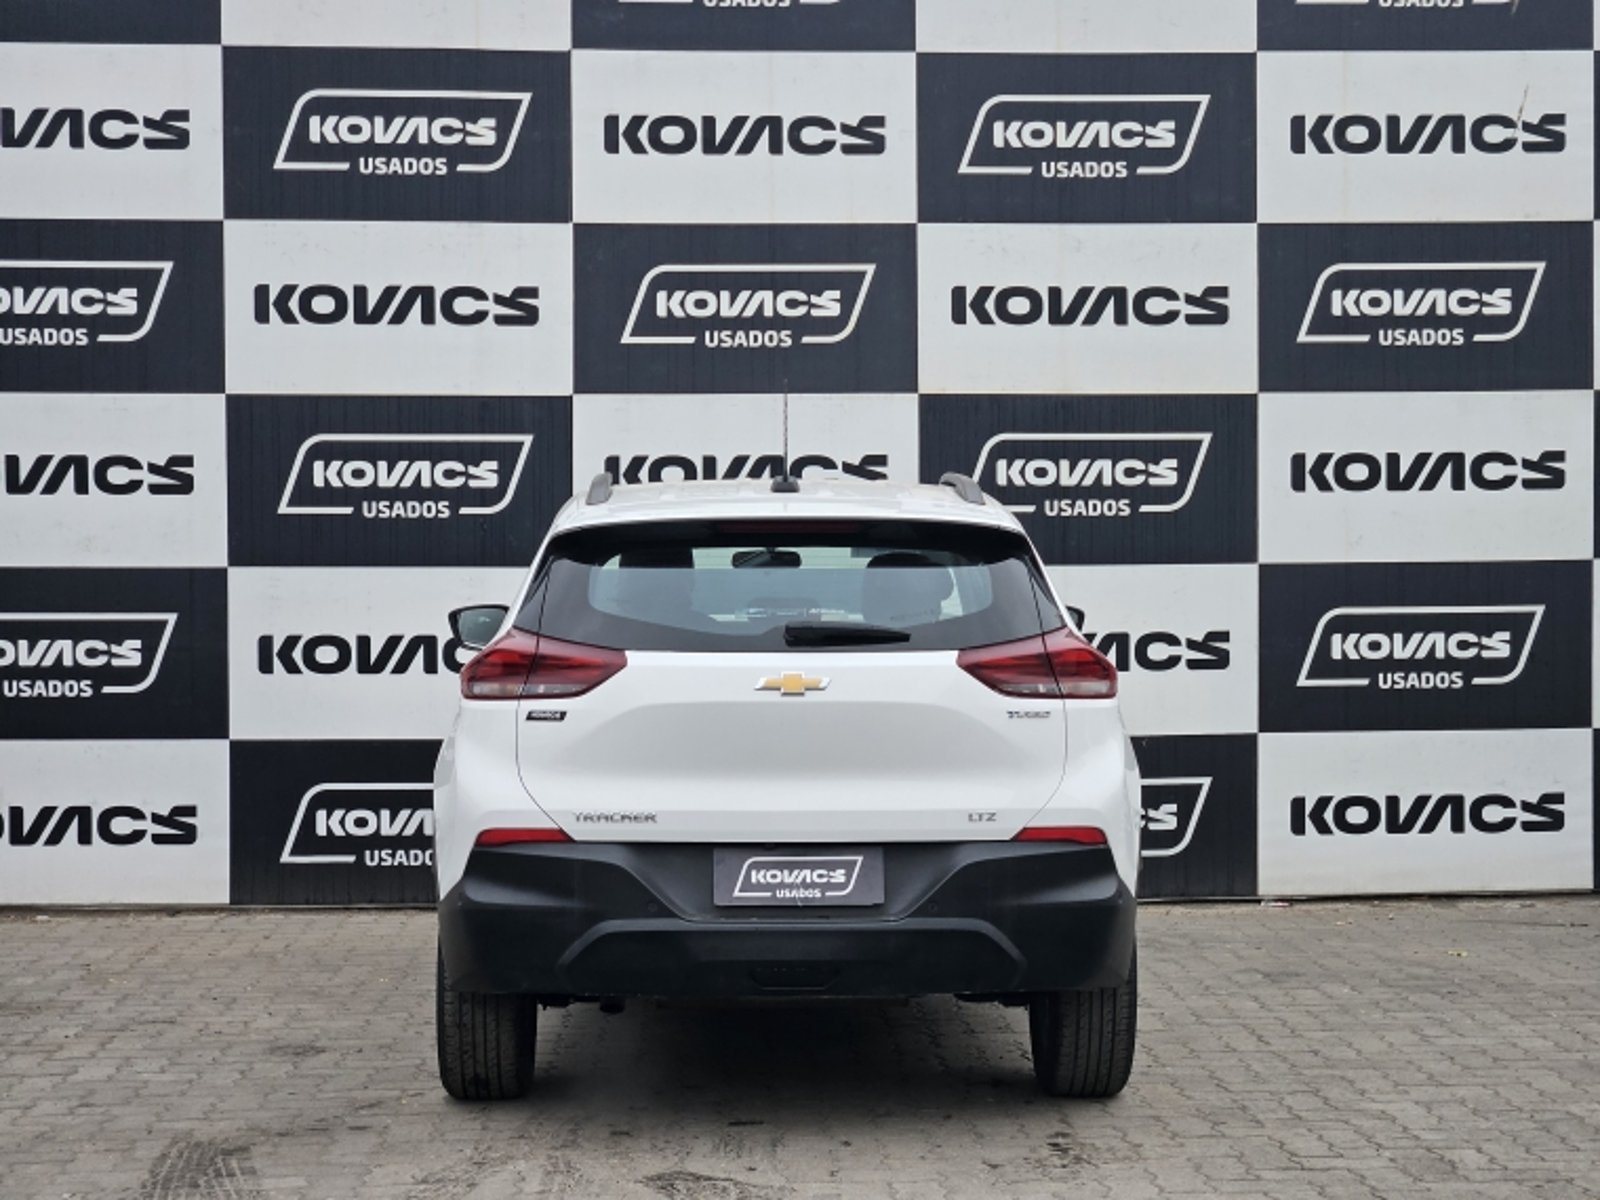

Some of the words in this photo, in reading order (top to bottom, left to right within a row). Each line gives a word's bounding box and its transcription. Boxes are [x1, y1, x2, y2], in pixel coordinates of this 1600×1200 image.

[309, 116, 496, 145] KOVACS
[604, 115, 886, 155] KOVACS
[993, 121, 1176, 148] KOVACS
[1291, 114, 1566, 154] KOVACS
[359, 158, 447, 175] USADOS
[1041, 162, 1127, 178] USADOS
[254, 284, 539, 326] KOVACS
[656, 290, 841, 318] KOVACS
[952, 286, 1229, 326] KOVACS
[1331, 288, 1512, 317] KOVACS
[0, 328, 88, 345] USADOS
[704, 330, 792, 348] USADOS
[1378, 329, 1464, 346] USADOS
[313, 460, 499, 488] KOVACS
[996, 459, 1177, 486] KOVACS
[1291, 451, 1566, 492] KOVACS
[363, 501, 450, 518] USADOS
[1044, 499, 1130, 516] USADOS
[1083, 631, 1230, 672] ACS
[1330, 631, 1510, 660] KOVACS
[3, 680, 93, 697] USADOS
[1378, 672, 1463, 688] USADOS
[0, 806, 197, 846] VACS
[968, 812, 997, 822] LTZ
[1291, 792, 1565, 836] KOVACS
[751, 869, 846, 884] KOVACS
